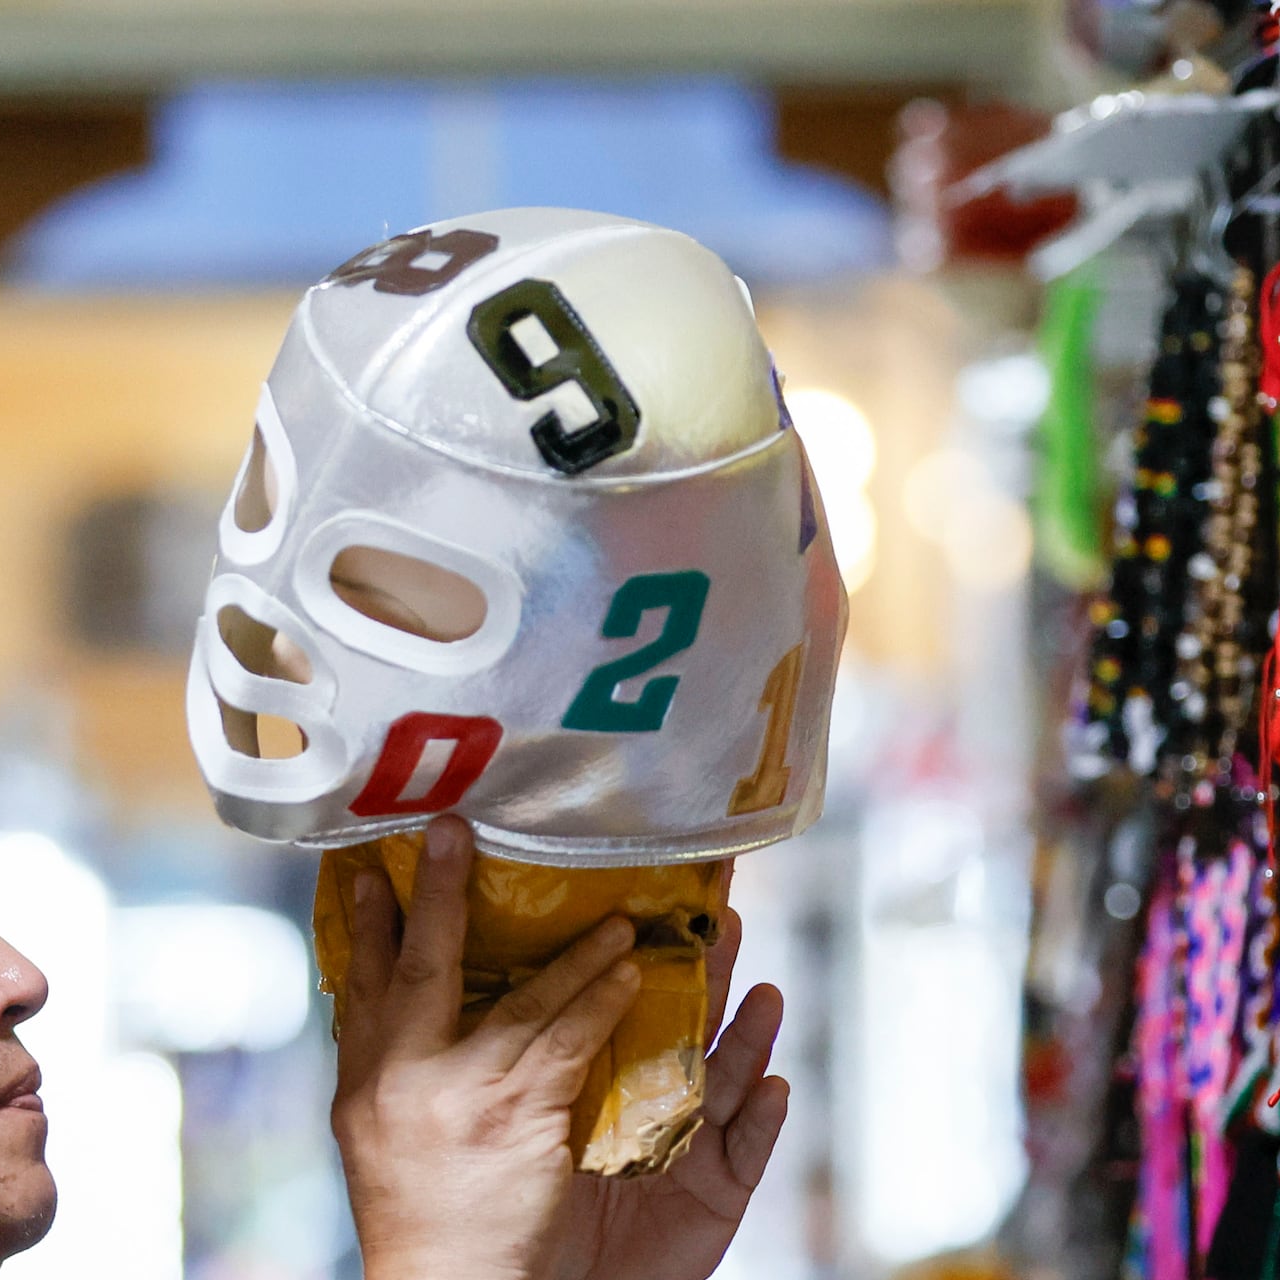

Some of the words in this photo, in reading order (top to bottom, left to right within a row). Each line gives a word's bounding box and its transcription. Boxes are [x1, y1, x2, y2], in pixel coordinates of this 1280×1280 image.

[327, 229, 499, 296] 8
[467, 278, 641, 475] 9
[561, 570, 711, 732] 2
[726, 641, 807, 818] 1
